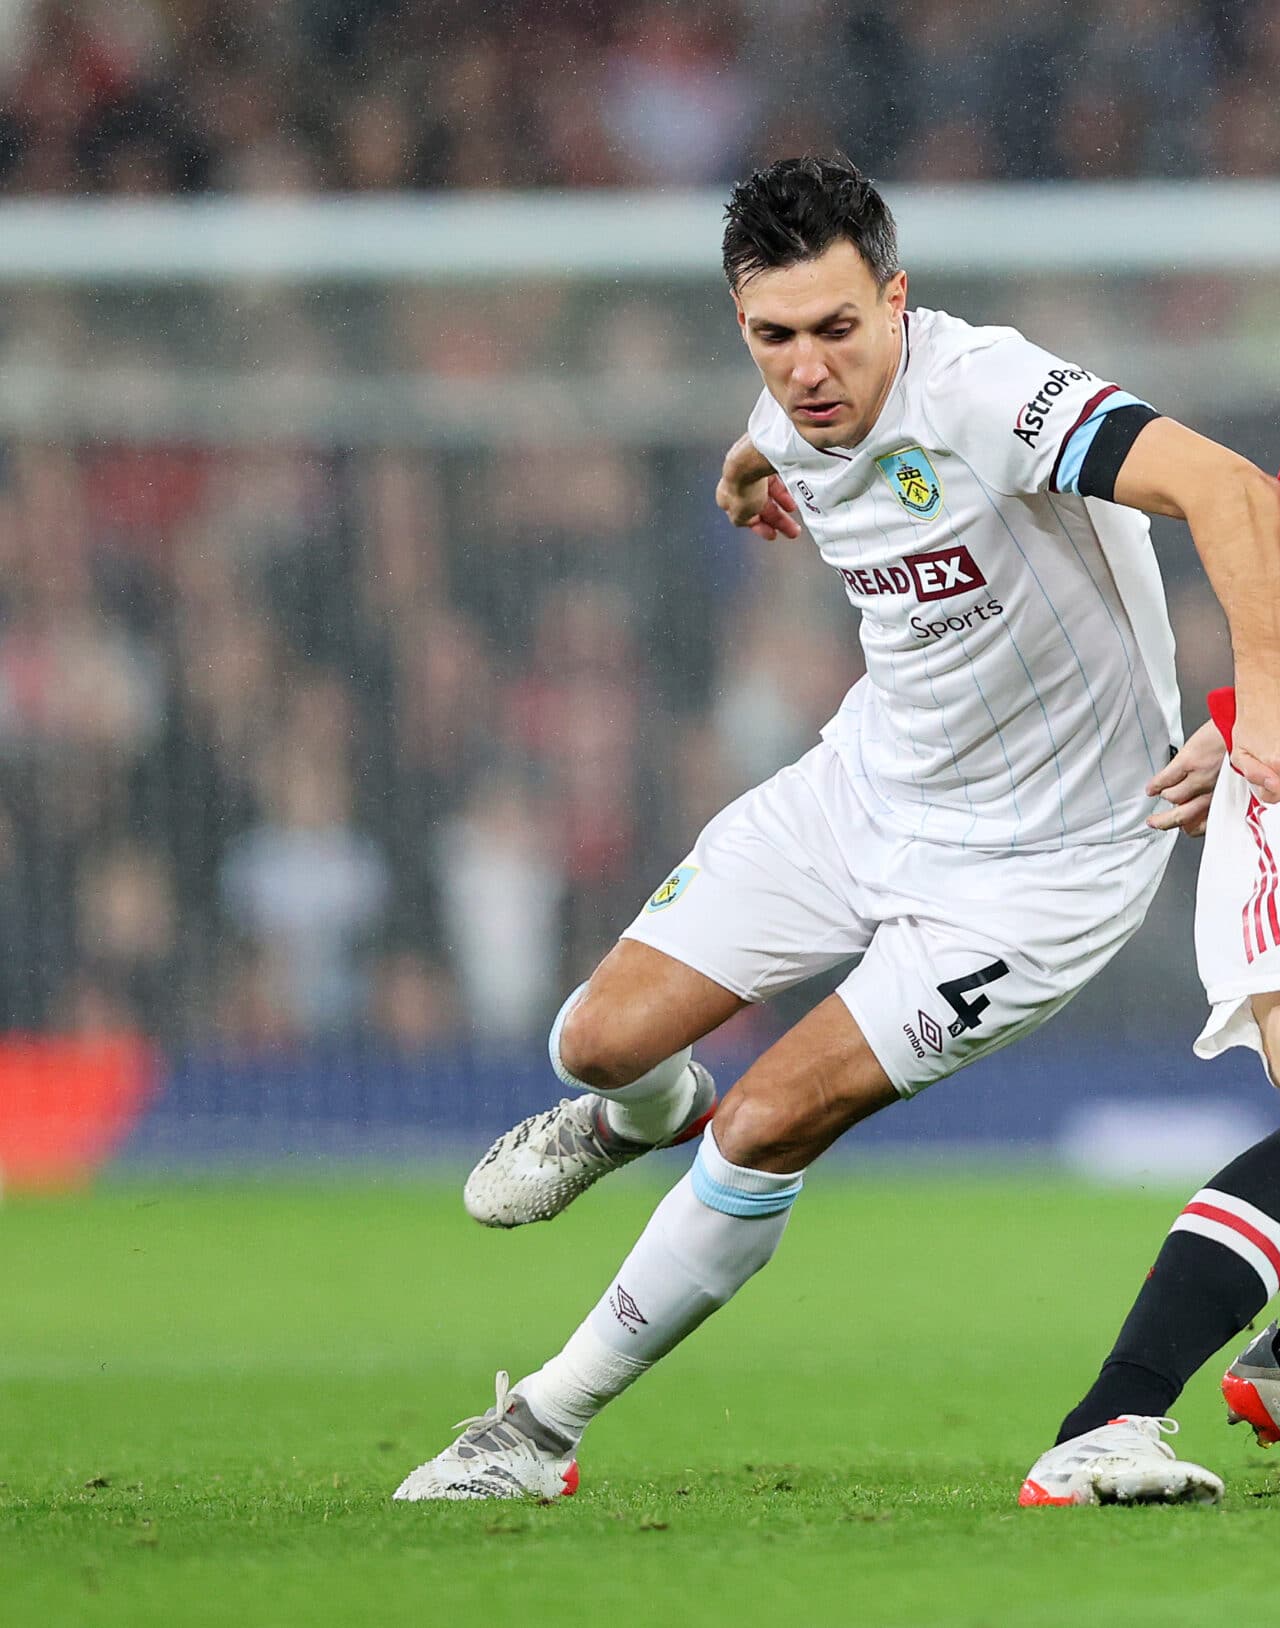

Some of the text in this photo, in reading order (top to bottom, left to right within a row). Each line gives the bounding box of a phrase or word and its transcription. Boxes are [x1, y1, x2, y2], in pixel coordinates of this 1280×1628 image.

[1013, 369, 1092, 449] AstroPay
[910, 599, 1004, 639] Sports
[936, 959, 1010, 1038] 4
[903, 1023, 925, 1058] umbro
